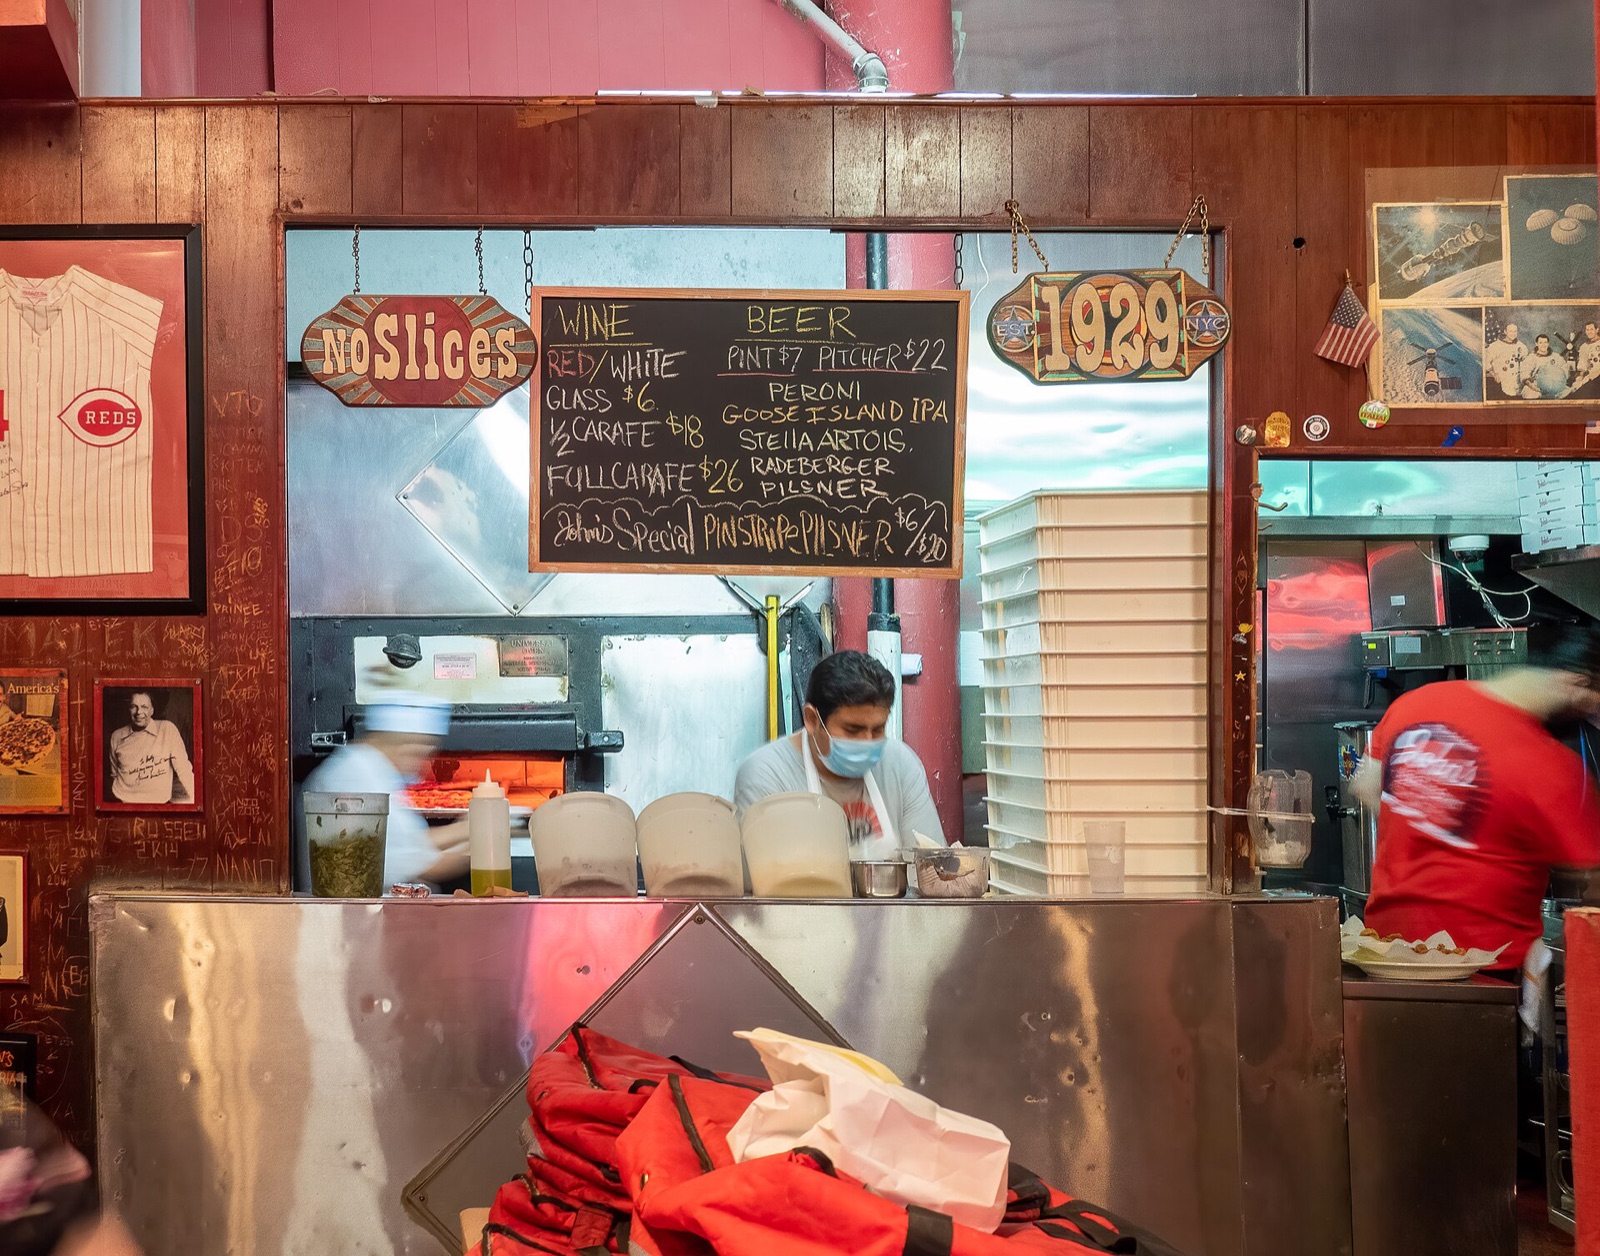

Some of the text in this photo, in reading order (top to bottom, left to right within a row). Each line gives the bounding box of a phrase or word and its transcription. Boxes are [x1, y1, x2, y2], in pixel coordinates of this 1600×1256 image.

[557, 302, 635, 341] WINE
[746, 305, 856, 338] BEER
[996, 322, 1036, 337] EST.
[1041, 280, 1180, 373] 1929
[1185, 316, 1226, 330] NYC
[727, 337, 948, 373] PINT $7 PITCHER $22
[546, 384, 612, 413] GLASS
[768, 380, 861, 402] PERONI
[84, 409, 138, 426] REDS
[722, 397, 949, 425] GOOSE ISLAND IPA
[572, 415, 662, 448] CARAFE
[665, 410, 705, 449] $18
[697, 454, 744, 493] $26
[750, 454, 897, 476] RADEBERGER
[760, 477, 890, 499] PILSNER
[8, 682, 60, 694] America's
